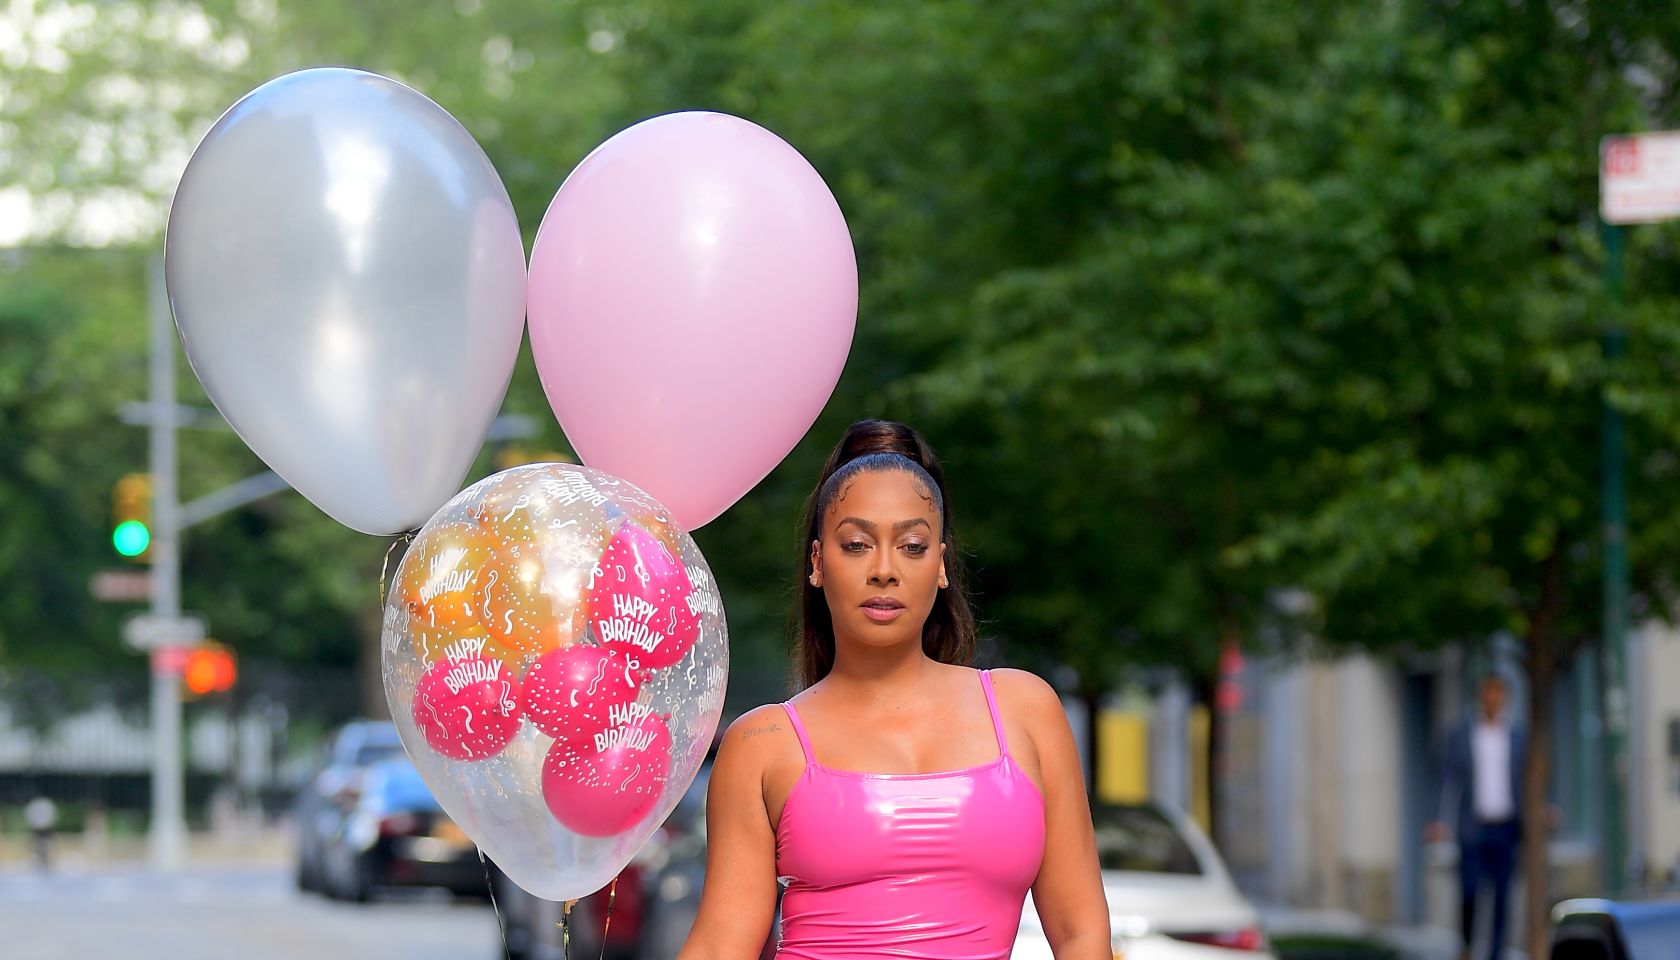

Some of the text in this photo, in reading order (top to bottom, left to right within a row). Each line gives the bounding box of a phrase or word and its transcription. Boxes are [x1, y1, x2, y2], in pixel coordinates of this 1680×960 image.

[684, 564, 709, 591] HAPPY
[612, 592, 659, 624] HAPPY
[599, 616, 665, 653] BIRTHDAY
[444, 637, 487, 666] HAPPY
[443, 659, 503, 695] BIRTHDAY
[608, 700, 654, 727] HAPPY
[594, 725, 658, 753] BIRTHDAY
